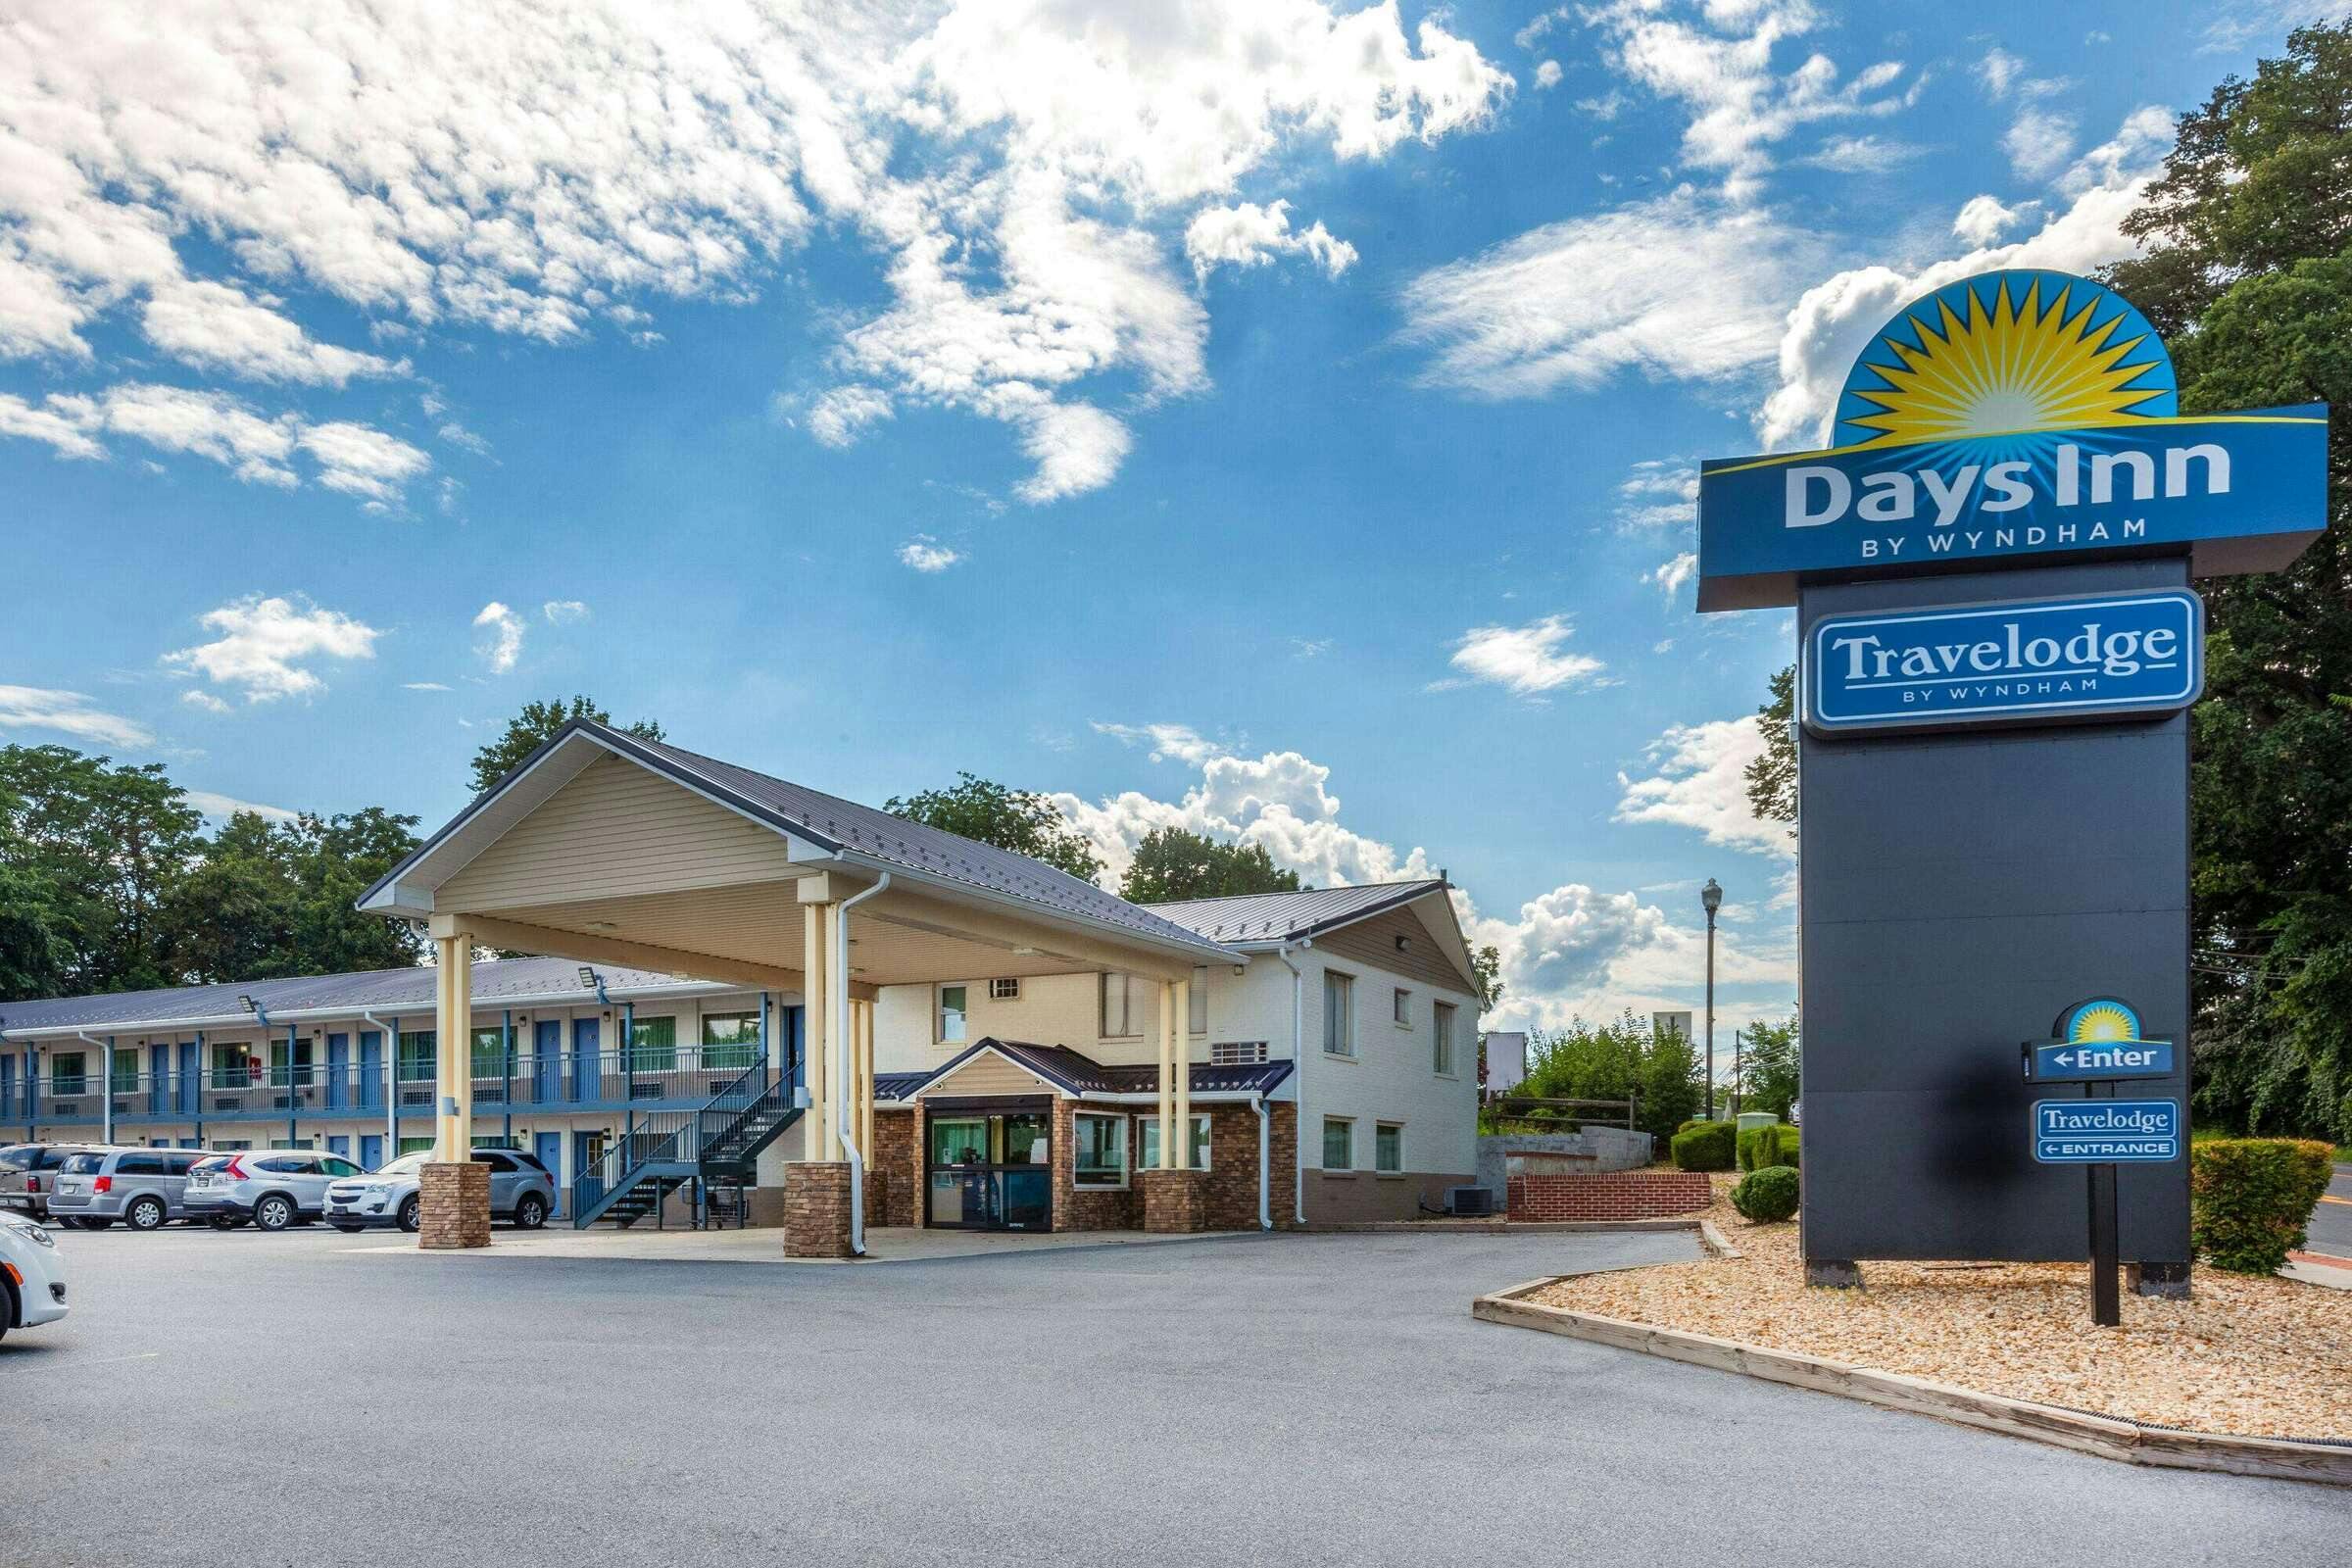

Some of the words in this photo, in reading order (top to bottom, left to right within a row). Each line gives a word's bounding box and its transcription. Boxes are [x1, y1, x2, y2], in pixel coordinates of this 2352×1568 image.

[1786, 461, 2034, 527] Days
[2056, 444, 2230, 507] Inn
[1862, 537, 1905, 558] BY
[1928, 518, 2145, 553] WYNDHAM
[1832, 623, 2177, 677] Travelodge
[1903, 690, 1935, 703] BY
[1950, 679, 2097, 700] WYNDHAM
[2078, 1048, 2158, 1068] Enter
[2043, 1108, 2169, 1133] Travelodge
[2062, 1143, 2170, 1154] ENTRANCE
